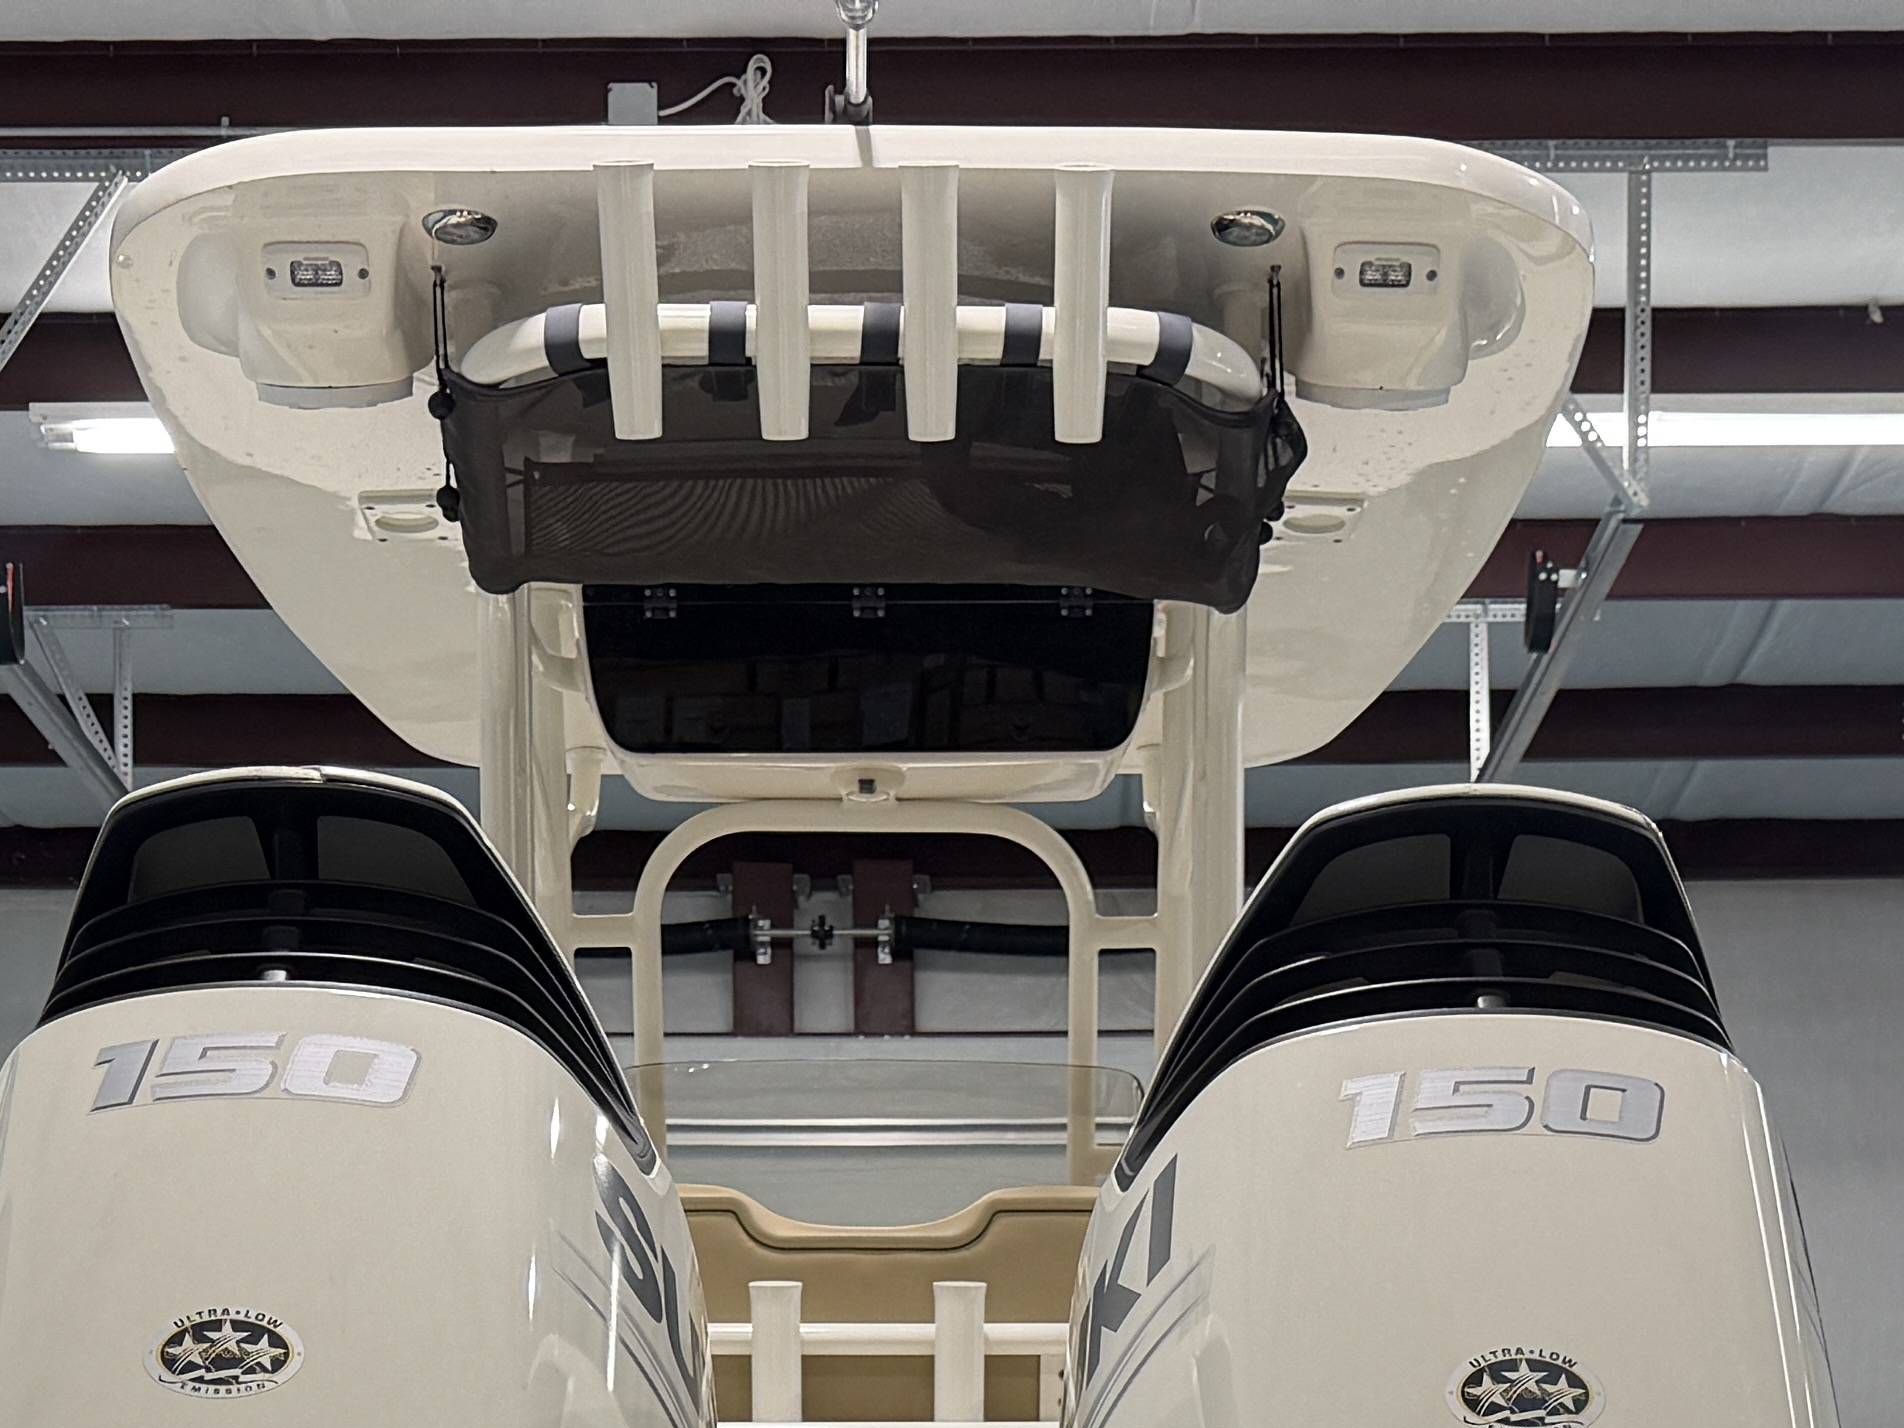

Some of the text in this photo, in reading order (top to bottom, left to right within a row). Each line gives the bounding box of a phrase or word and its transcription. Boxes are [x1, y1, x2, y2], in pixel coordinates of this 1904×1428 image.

[90, 1031, 422, 1113] 150
[1341, 1066, 1665, 1147] 150
[180, 1383, 266, 1395] EMISSION
